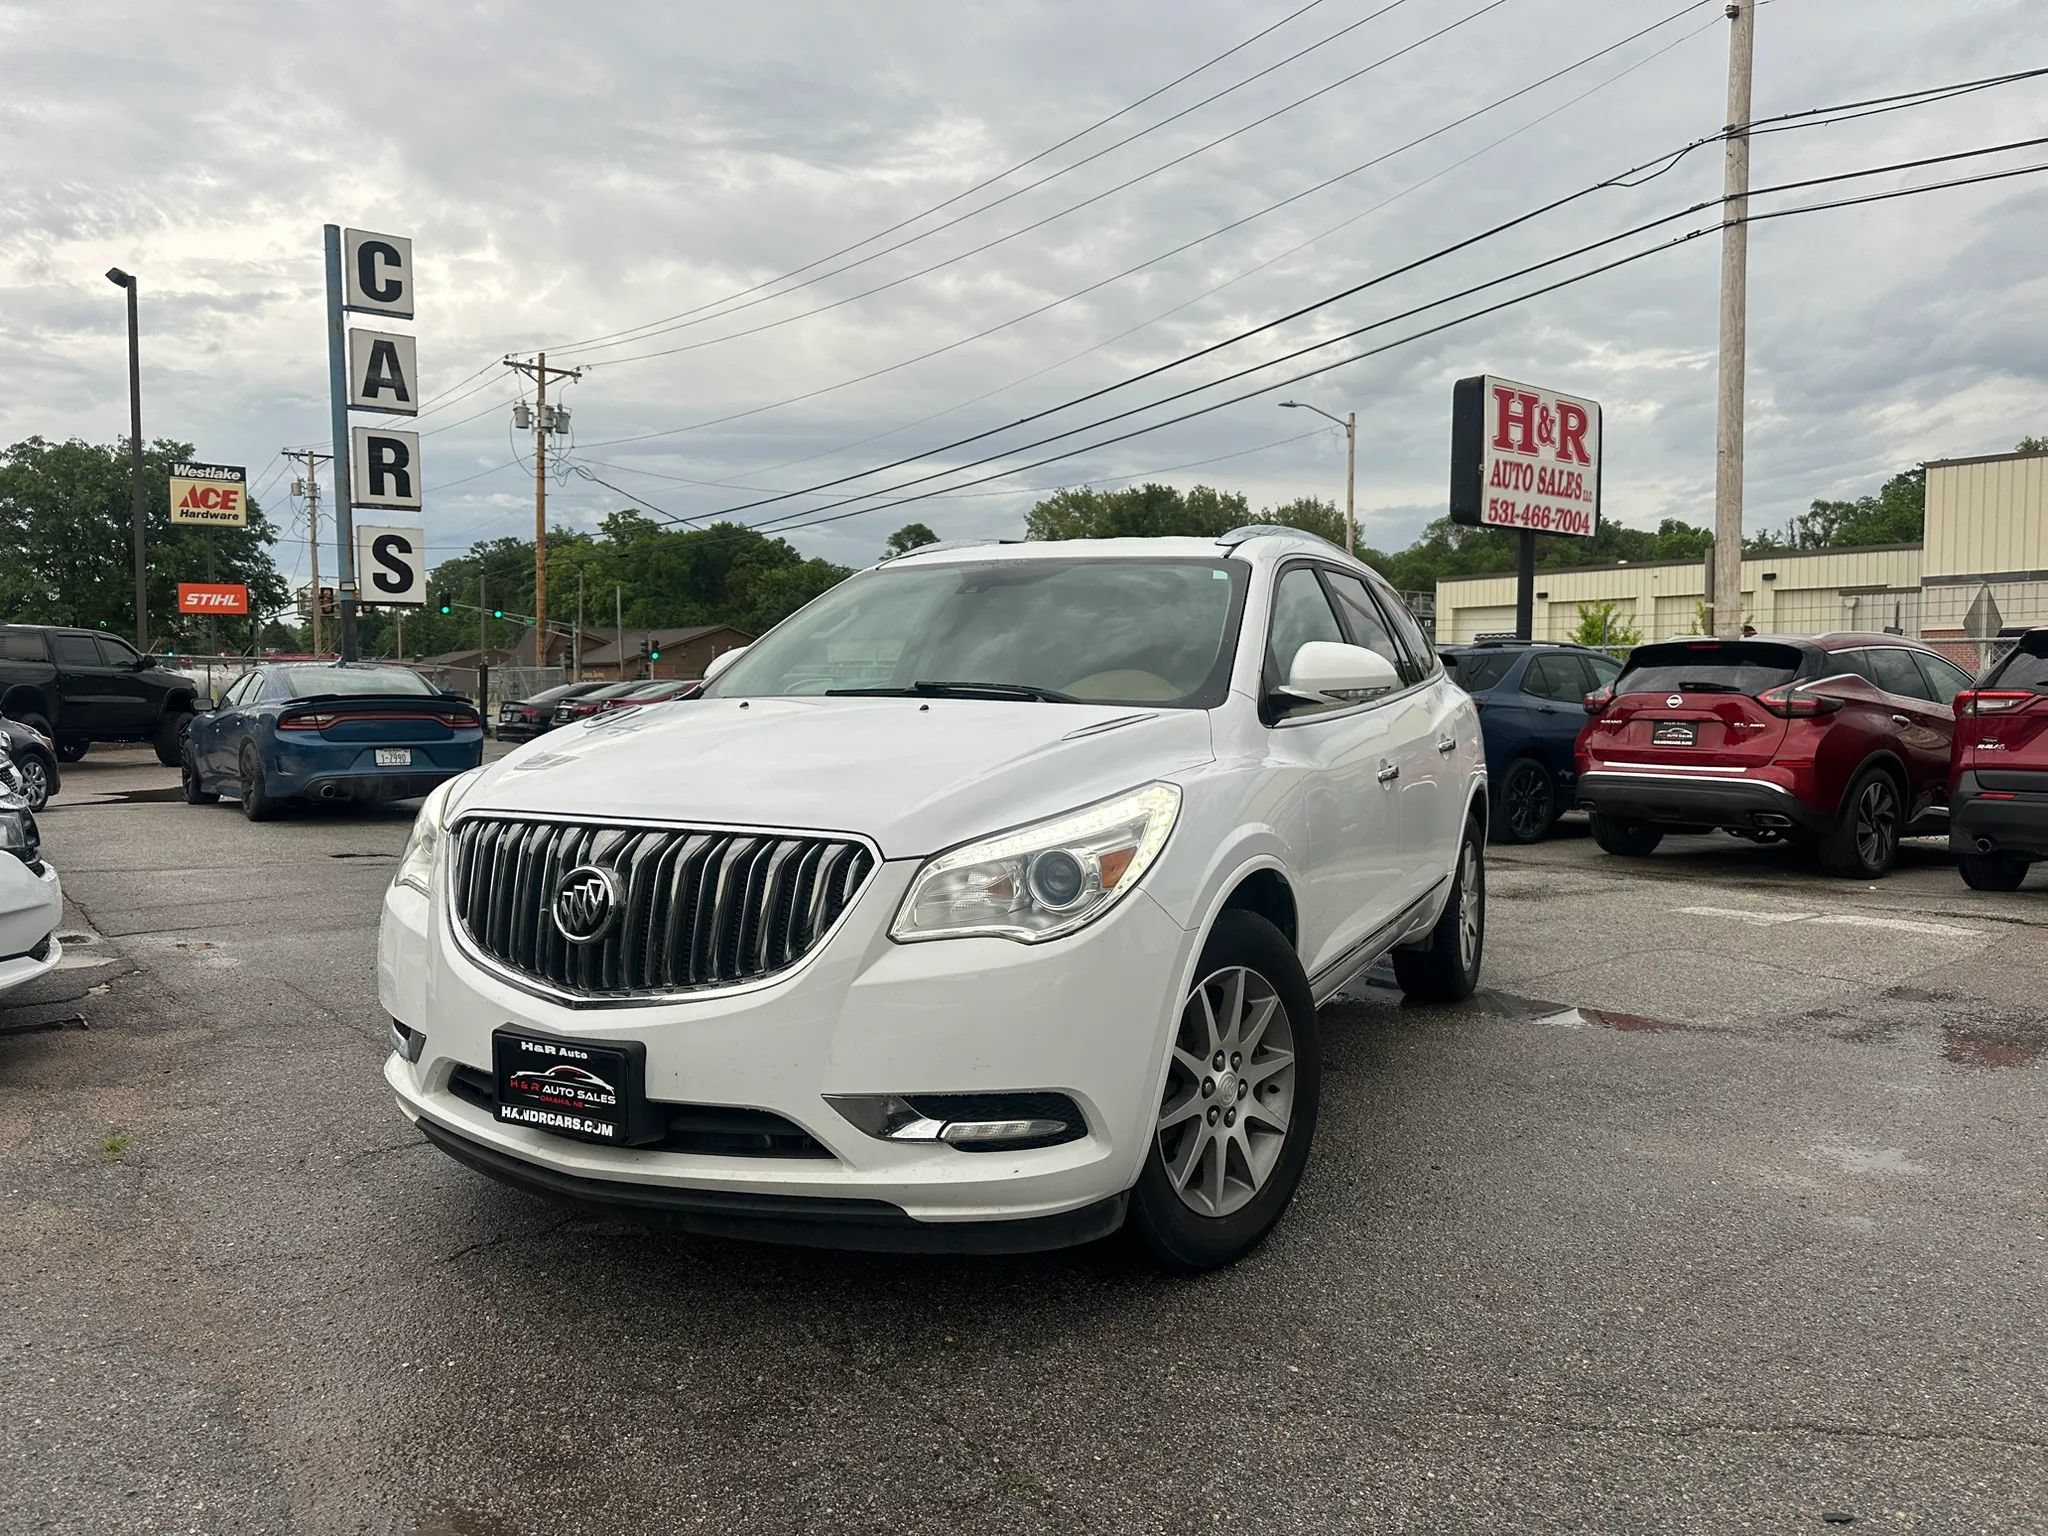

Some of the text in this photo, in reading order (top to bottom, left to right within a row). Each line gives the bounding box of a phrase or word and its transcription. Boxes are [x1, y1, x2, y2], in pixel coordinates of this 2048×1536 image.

[357, 240, 414, 594] CARS
[1492, 384, 1591, 467] H&R
[173, 463, 241, 480] Westlake
[1489, 459, 1534, 492] AUTO
[1537, 467, 1583, 500] SALES
[179, 484, 239, 510] ACE
[180, 509, 239, 521] Hardware
[1488, 497, 1590, 534] 531-466-7004
[185, 593, 240, 606] STIHL
[521, 1041, 588, 1060] H&R Auto
[542, 1085, 575, 1097] AUTO
[577, 1090, 616, 1105] SALES
